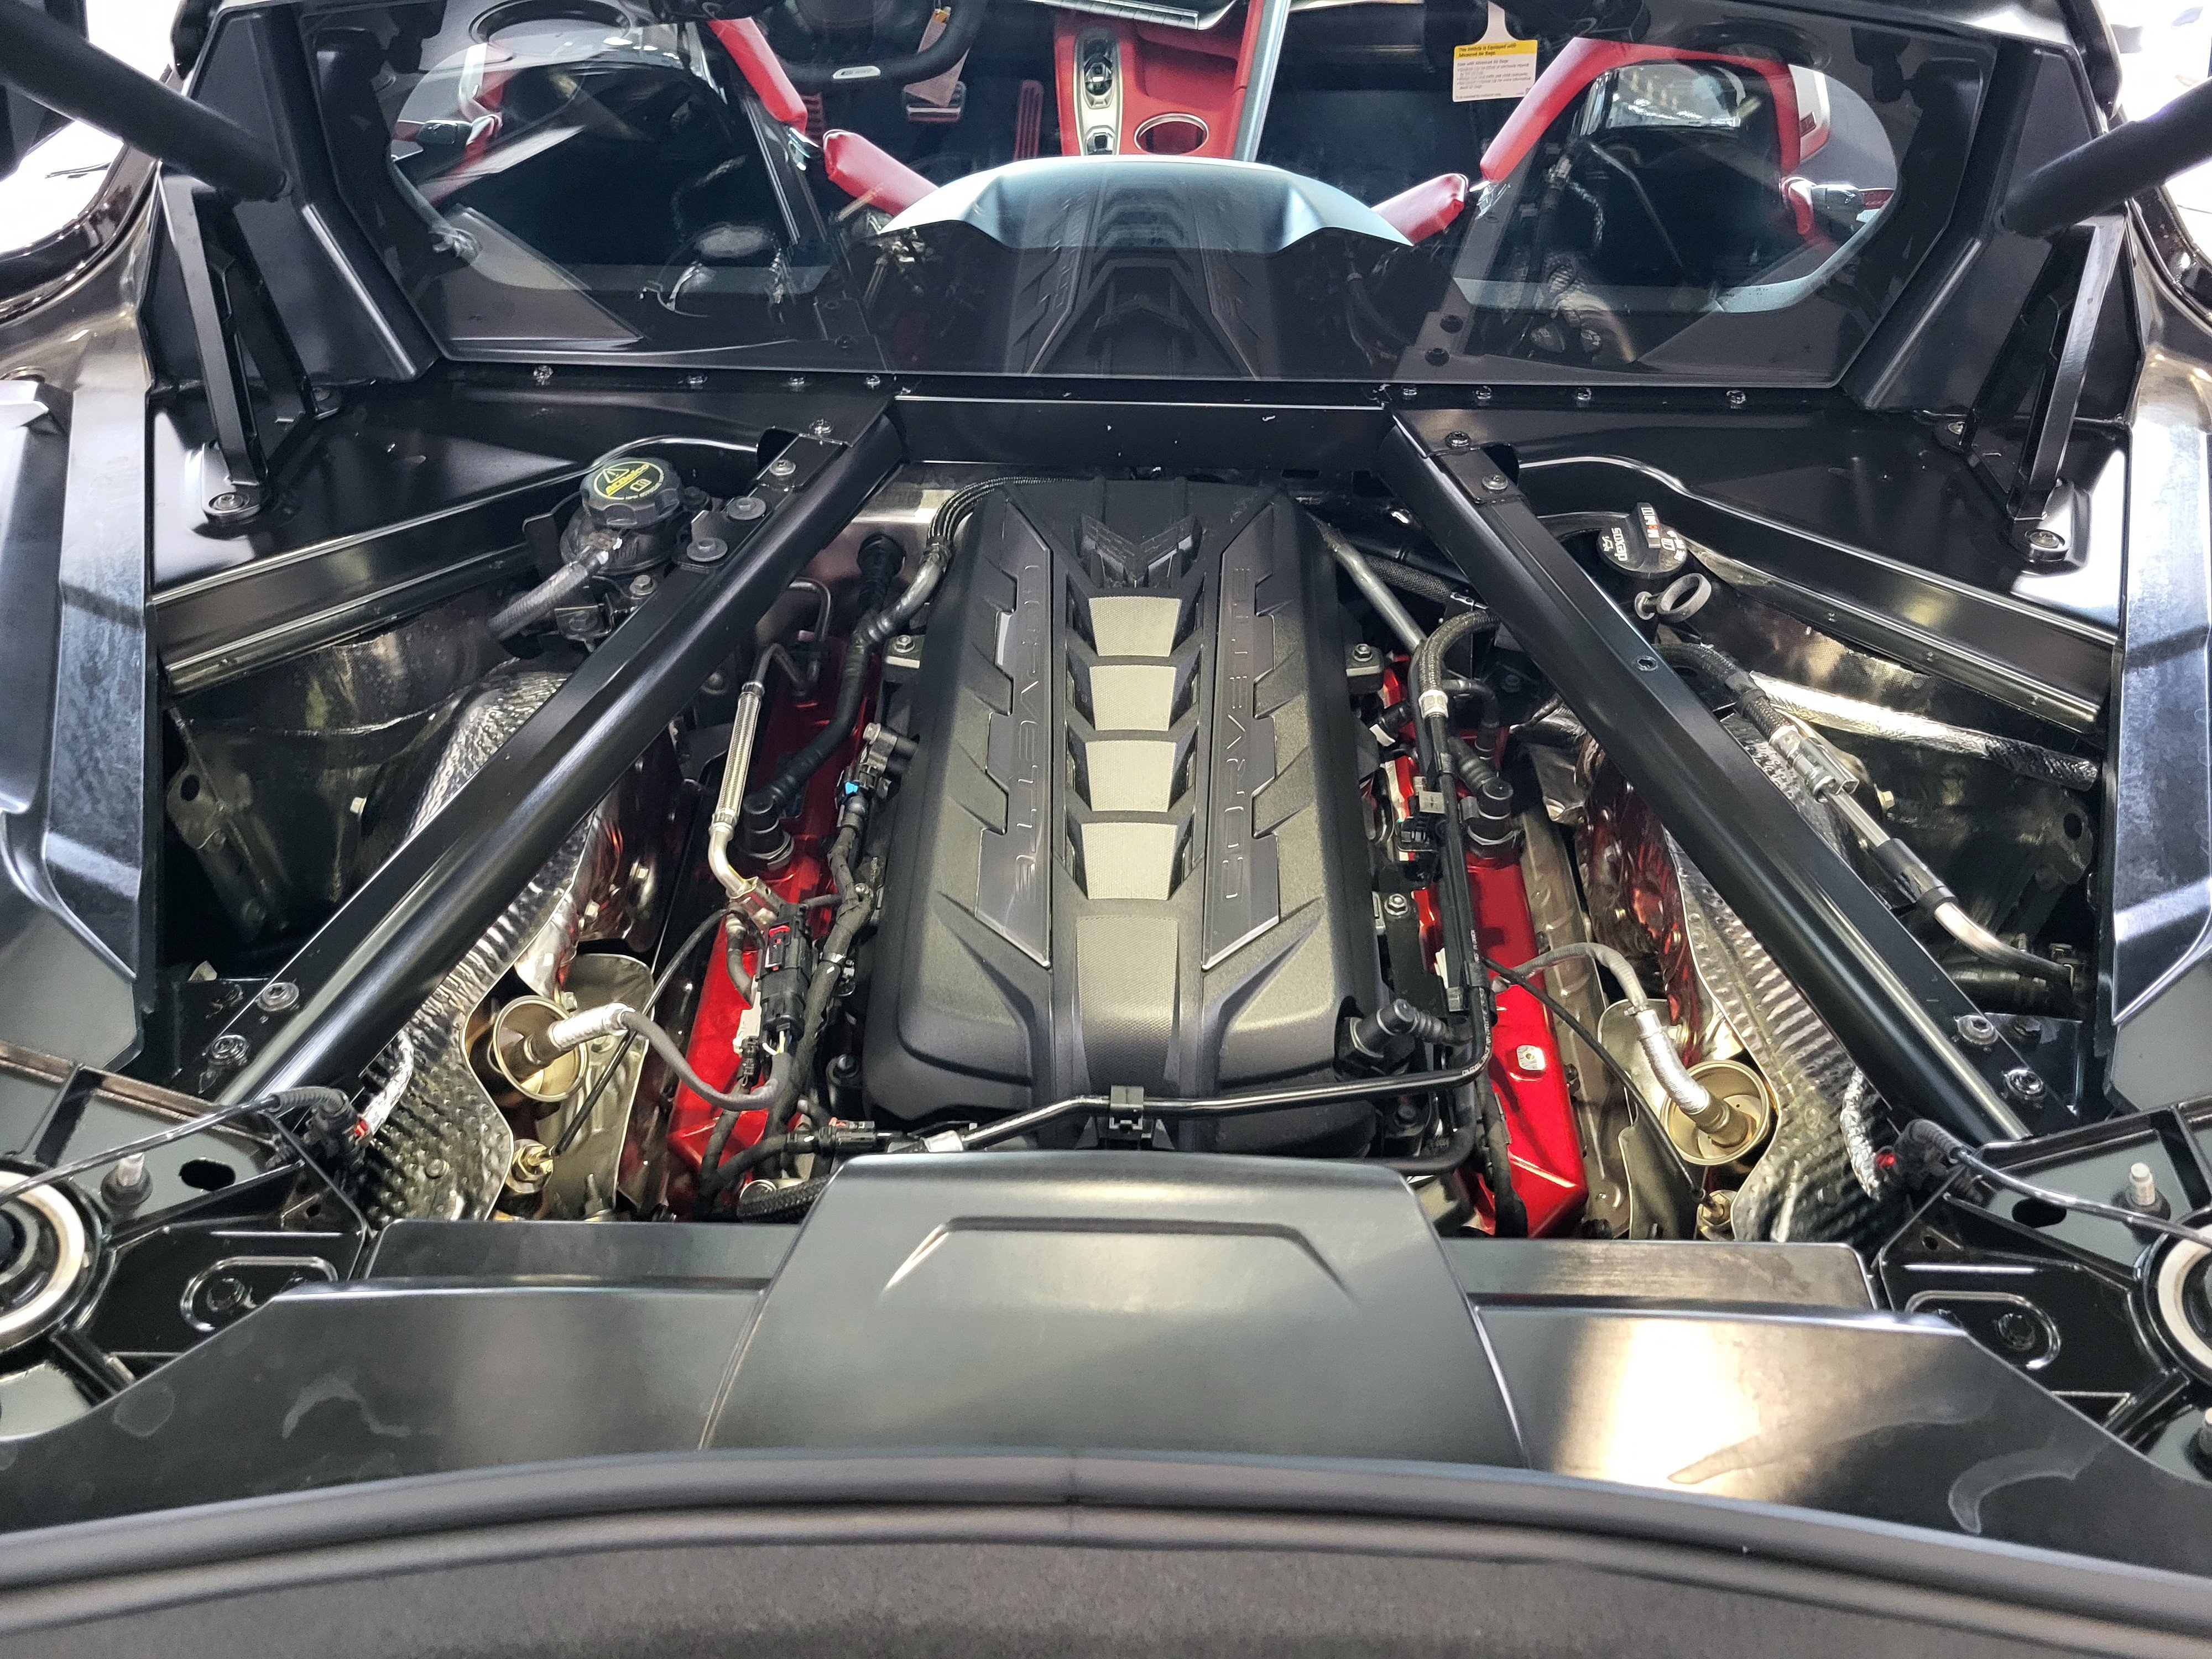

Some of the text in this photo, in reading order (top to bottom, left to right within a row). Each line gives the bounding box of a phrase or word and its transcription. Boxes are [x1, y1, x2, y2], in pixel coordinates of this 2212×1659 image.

[1611, 528, 1628, 561] dexos
[1015, 564, 1040, 900] CORVETTE
[1222, 568, 1249, 899] CORVETTE
